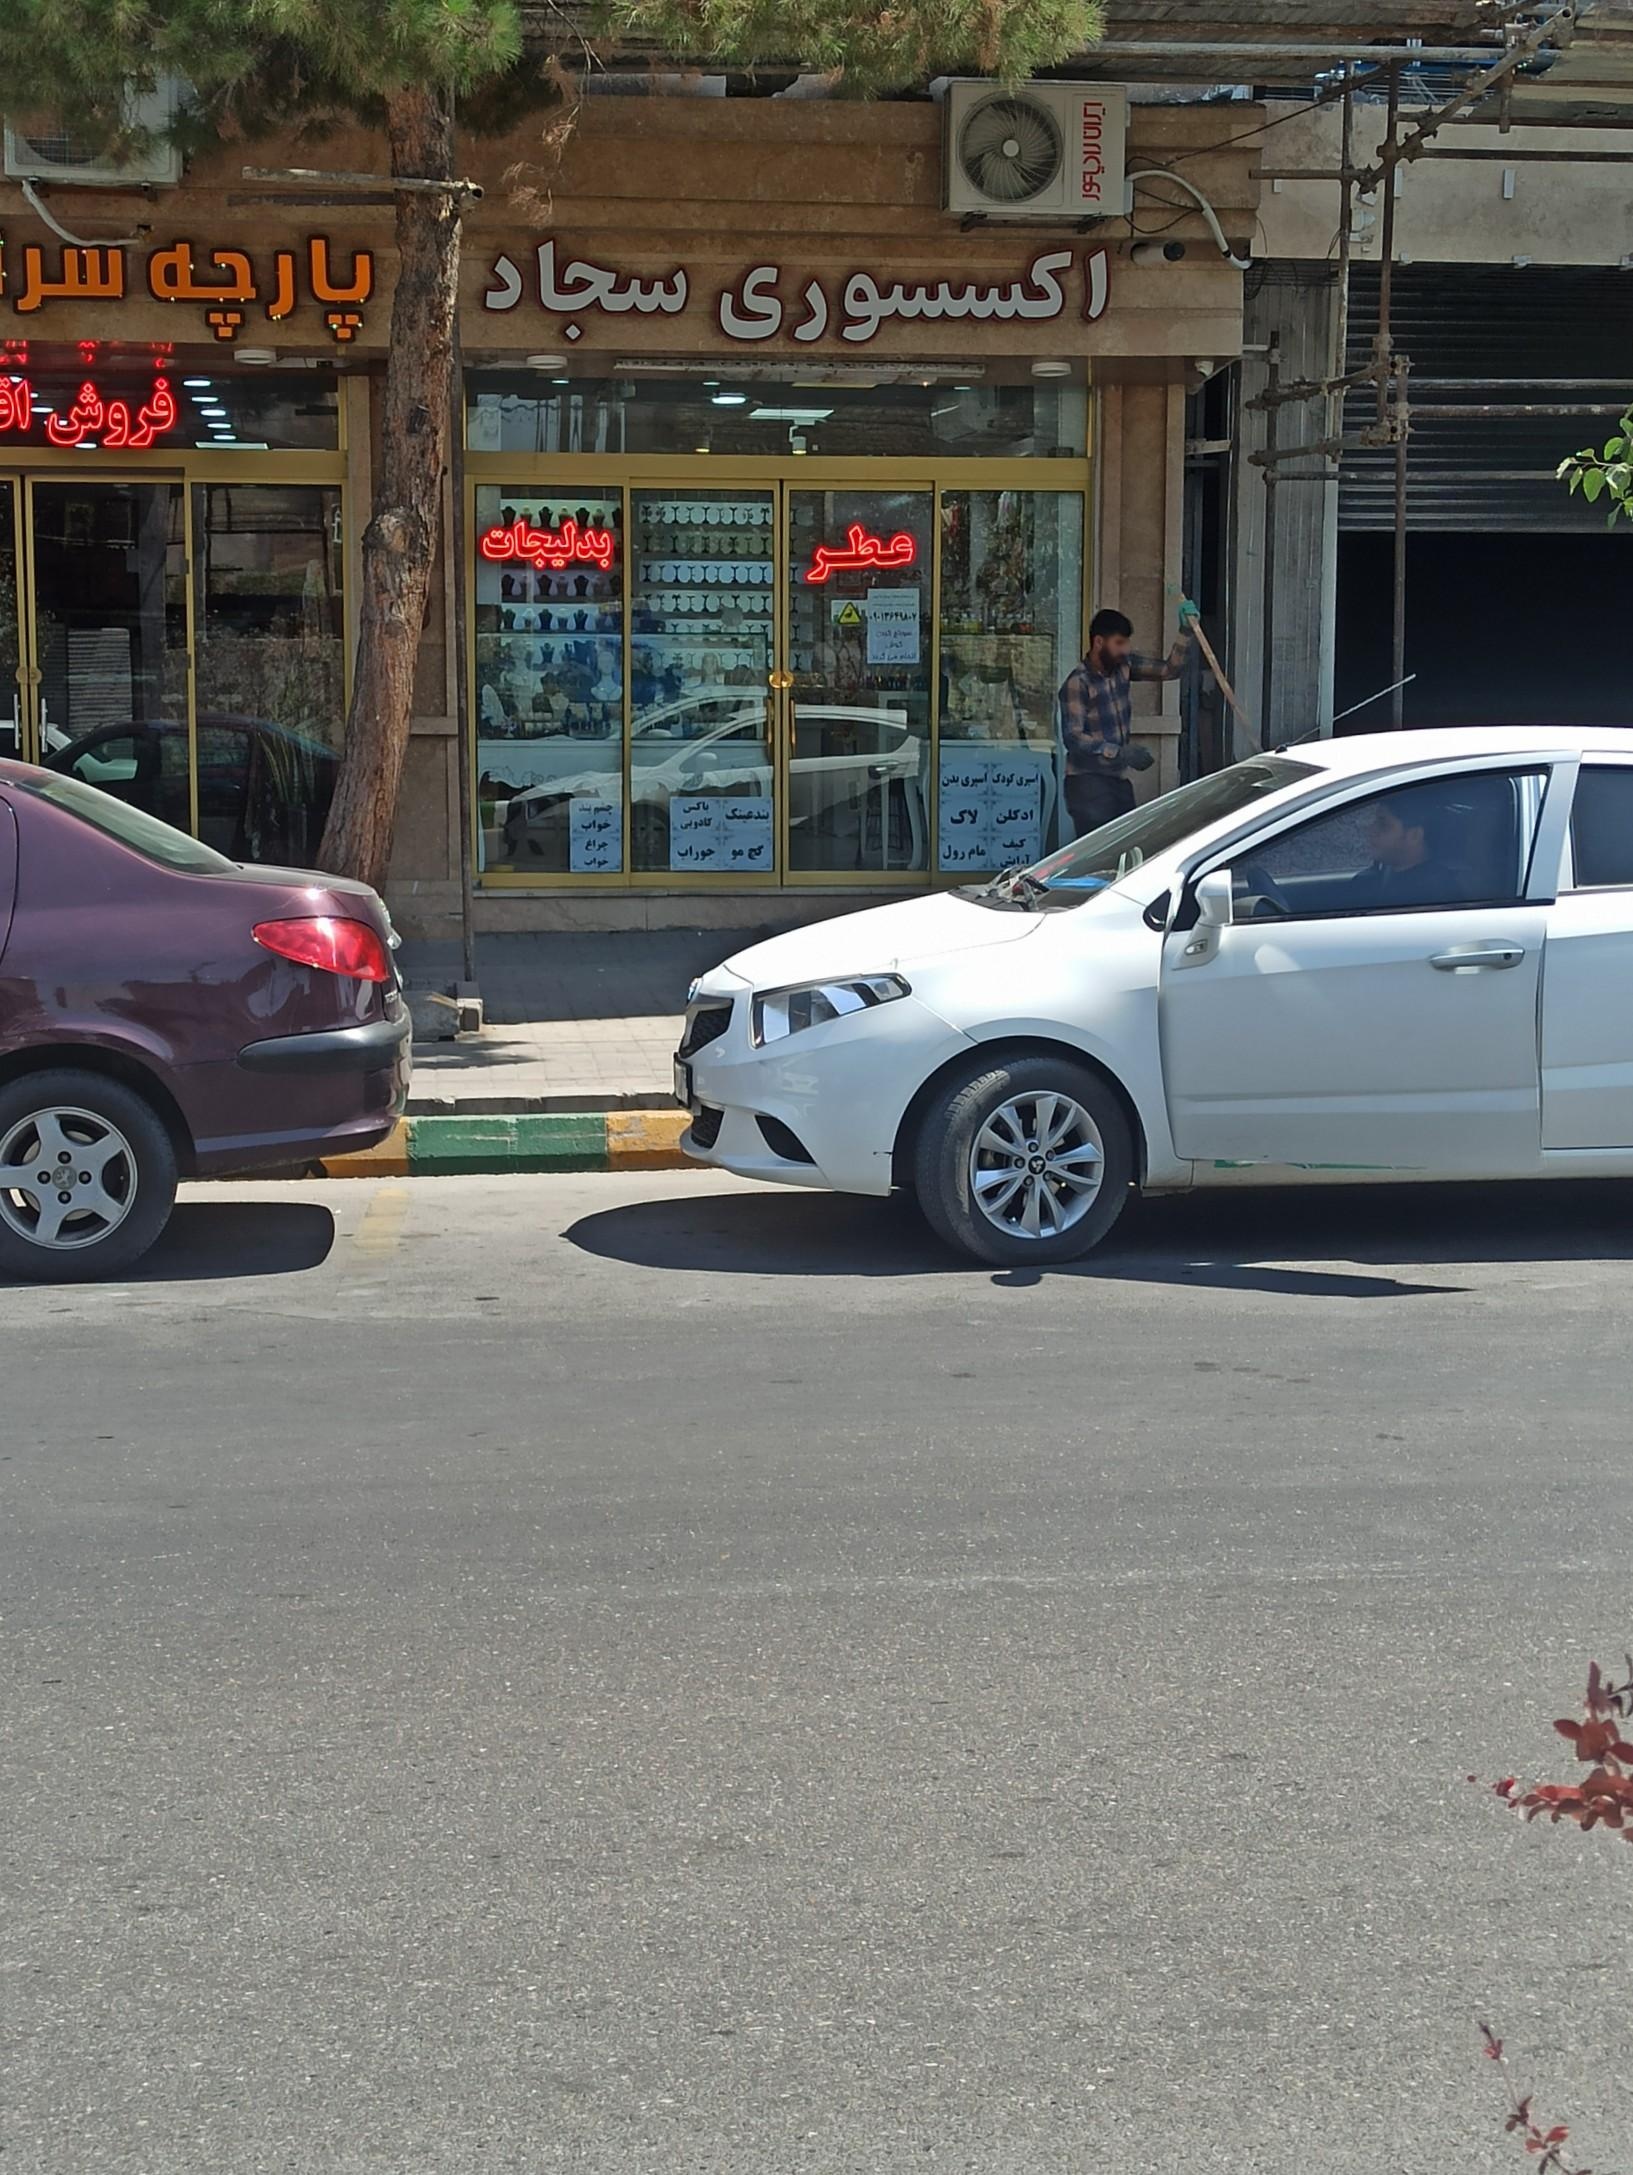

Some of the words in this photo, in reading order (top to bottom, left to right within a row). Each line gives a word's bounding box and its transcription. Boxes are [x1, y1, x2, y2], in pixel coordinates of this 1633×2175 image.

[149, 238, 373, 339] پارچه
[485, 239, 688, 341] سجاد
[719, 248, 1108, 342] اکسسوری
[47, 377, 176, 446] فروش
[481, 519, 613, 569] بدلیجات
[806, 523, 915, 583] عطر
[941, 774, 960, 788] بدن
[991, 772, 1015, 787] کودک
[950, 808, 978, 825] لاک
[995, 808, 1034, 825] ادکلن
[677, 845, 715, 861] جوراب
[942, 844, 966, 861] رول
[968, 844, 987, 860] مام
[1002, 838, 1027, 851] کیف
[731, 848, 744, 860] مو
